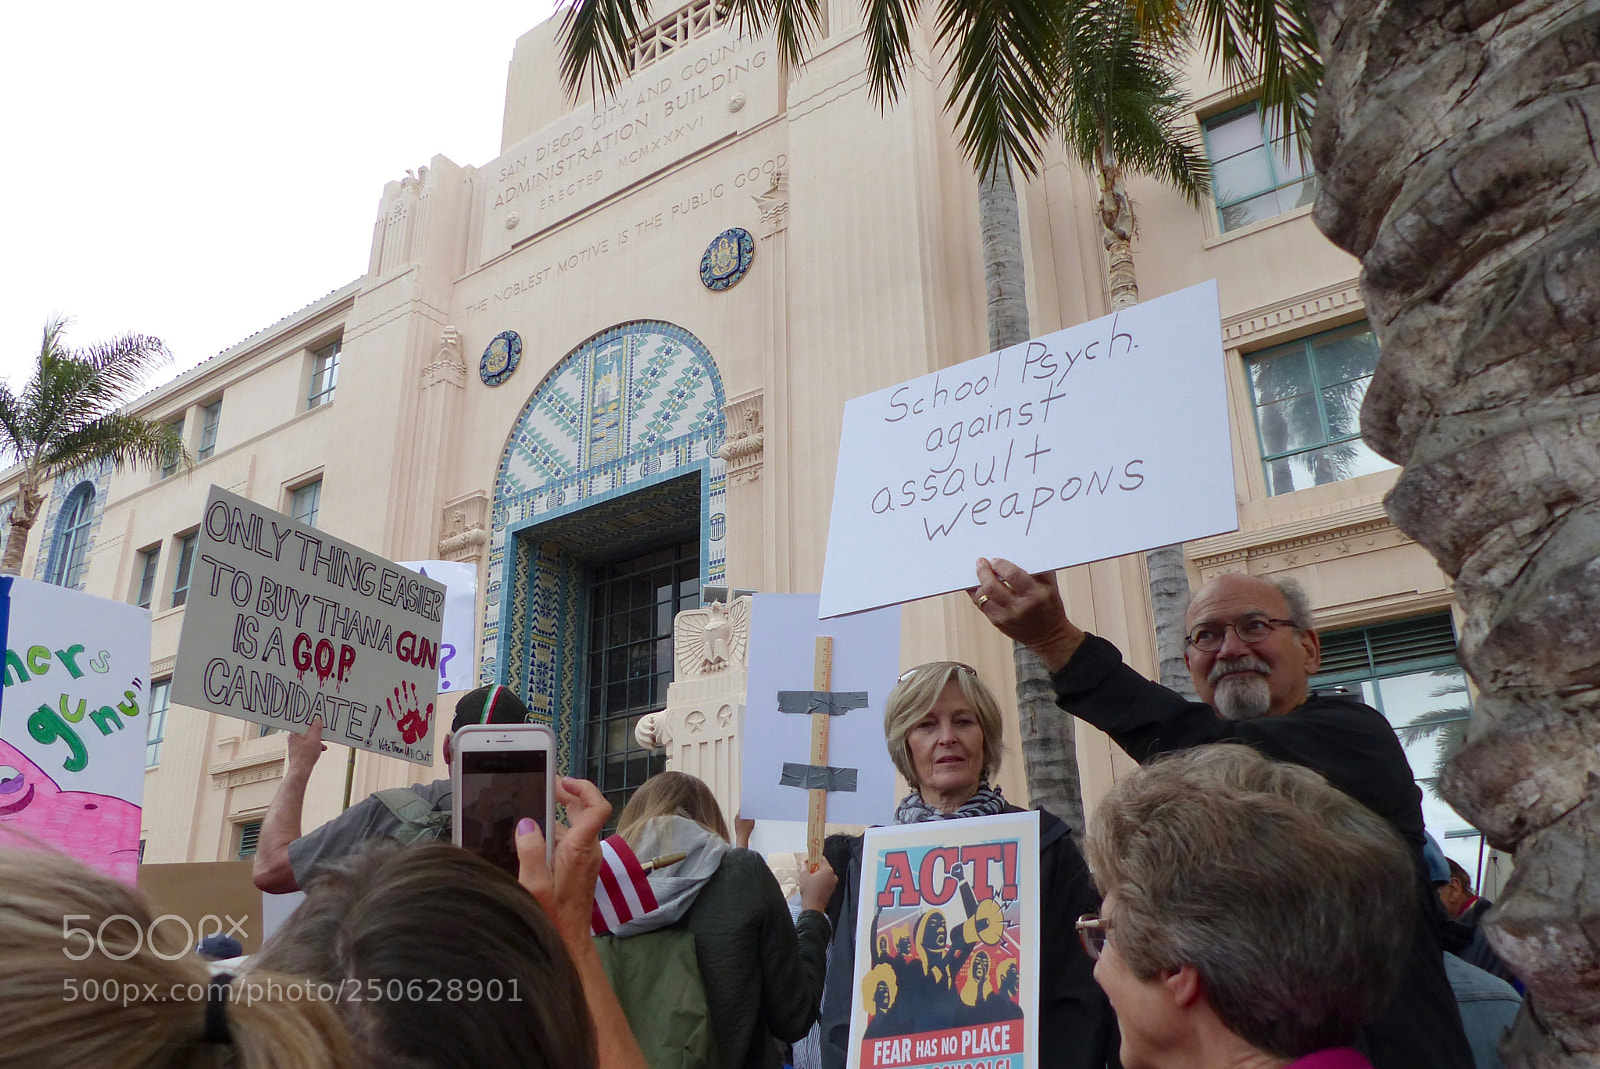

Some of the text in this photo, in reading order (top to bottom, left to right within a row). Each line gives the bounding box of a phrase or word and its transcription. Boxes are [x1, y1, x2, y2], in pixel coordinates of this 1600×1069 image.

[493, 51, 766, 210] ADMINISTRATION BUILDING
[499, 156, 527, 182] SAN
[536, 126, 584, 162] DIEGO
[591, 99, 629, 130] CITY
[636, 78, 672, 108] AND
[540, 116, 704, 210] ERECTED MCMXXXVI
[465, 154, 787, 318] THE NOBLEST MOTIVE IS THE PUBLIC GOOD
[884, 313, 1139, 422] School Psych.
[871, 434, 1052, 514] assault
[926, 380, 1067, 474] against
[206, 500, 445, 623] ONLY THING EASIER
[202, 554, 438, 670] TO BUY THAN A GUN
[233, 613, 259, 660] IS
[262, 626, 286, 666] A
[203, 657, 383, 749] CANDIDATE!
[877, 841, 1019, 907] ACT!
[873, 1038, 912, 1066] FEAR
[915, 1038, 938, 1059] HAS
[941, 1036, 958, 1055] NO
[961, 1025, 1011, 1056] PLACE
